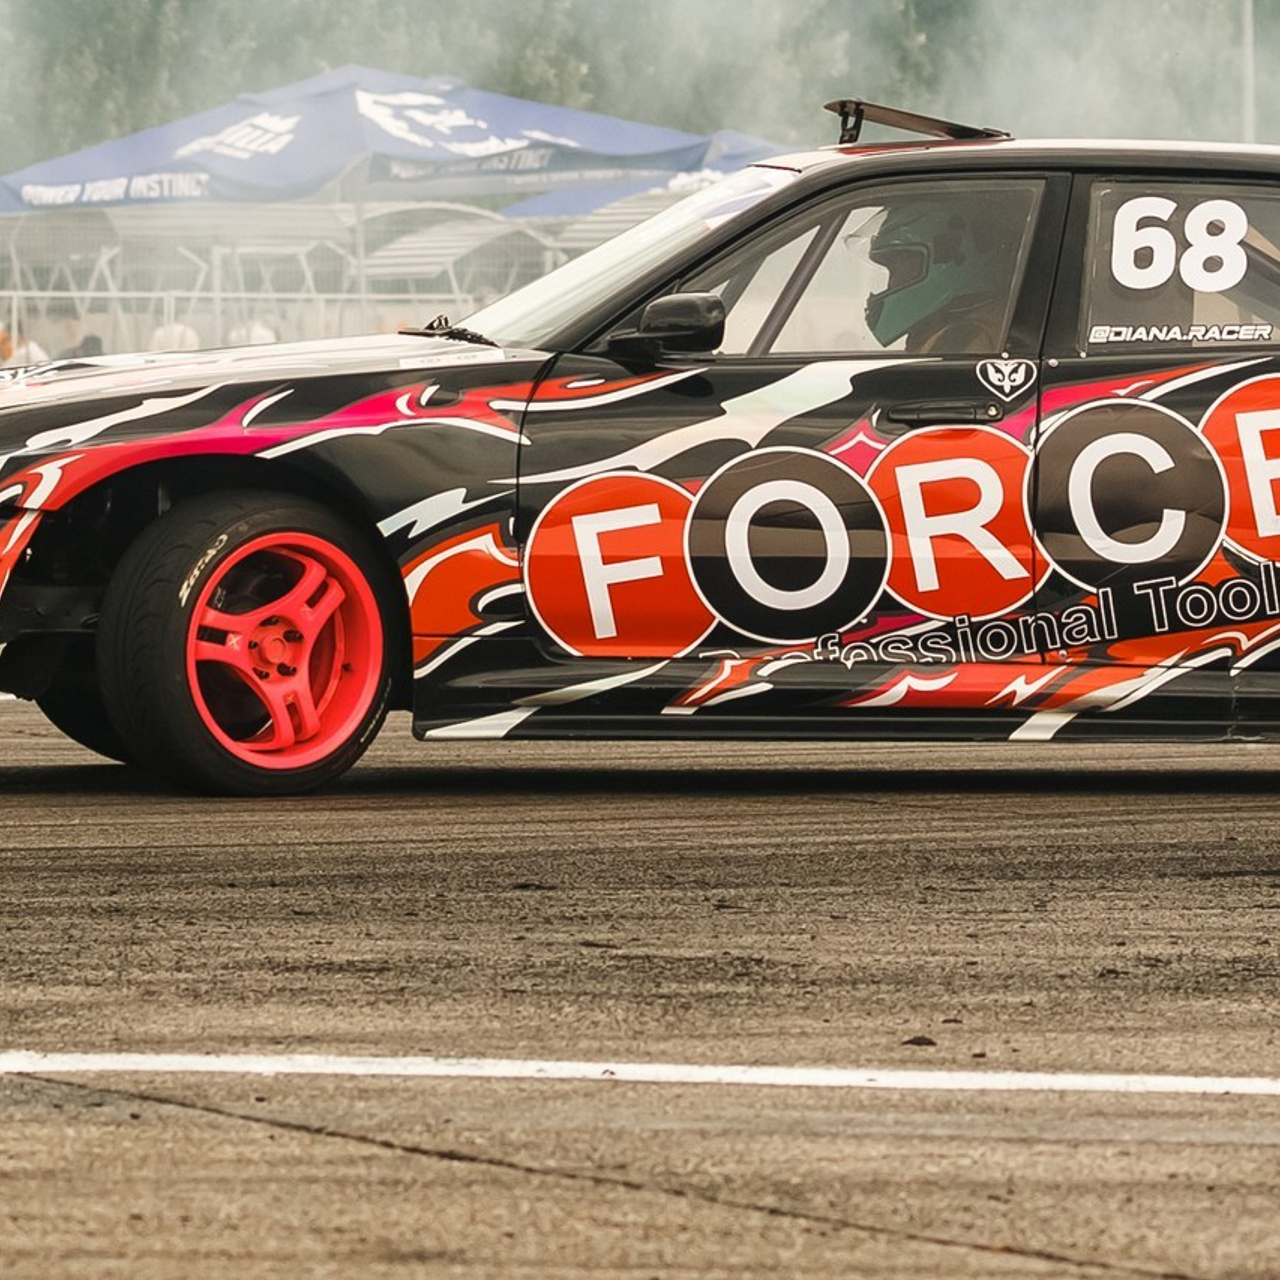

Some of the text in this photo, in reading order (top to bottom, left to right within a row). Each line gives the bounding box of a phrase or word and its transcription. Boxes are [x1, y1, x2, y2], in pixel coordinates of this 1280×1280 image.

[129, 172, 210, 199] INSTINCT
[1110, 196, 1249, 293] 68
[1088, 324, 1273, 344] @DIANA.RACER
[698, 588, 1120, 662] fessional
